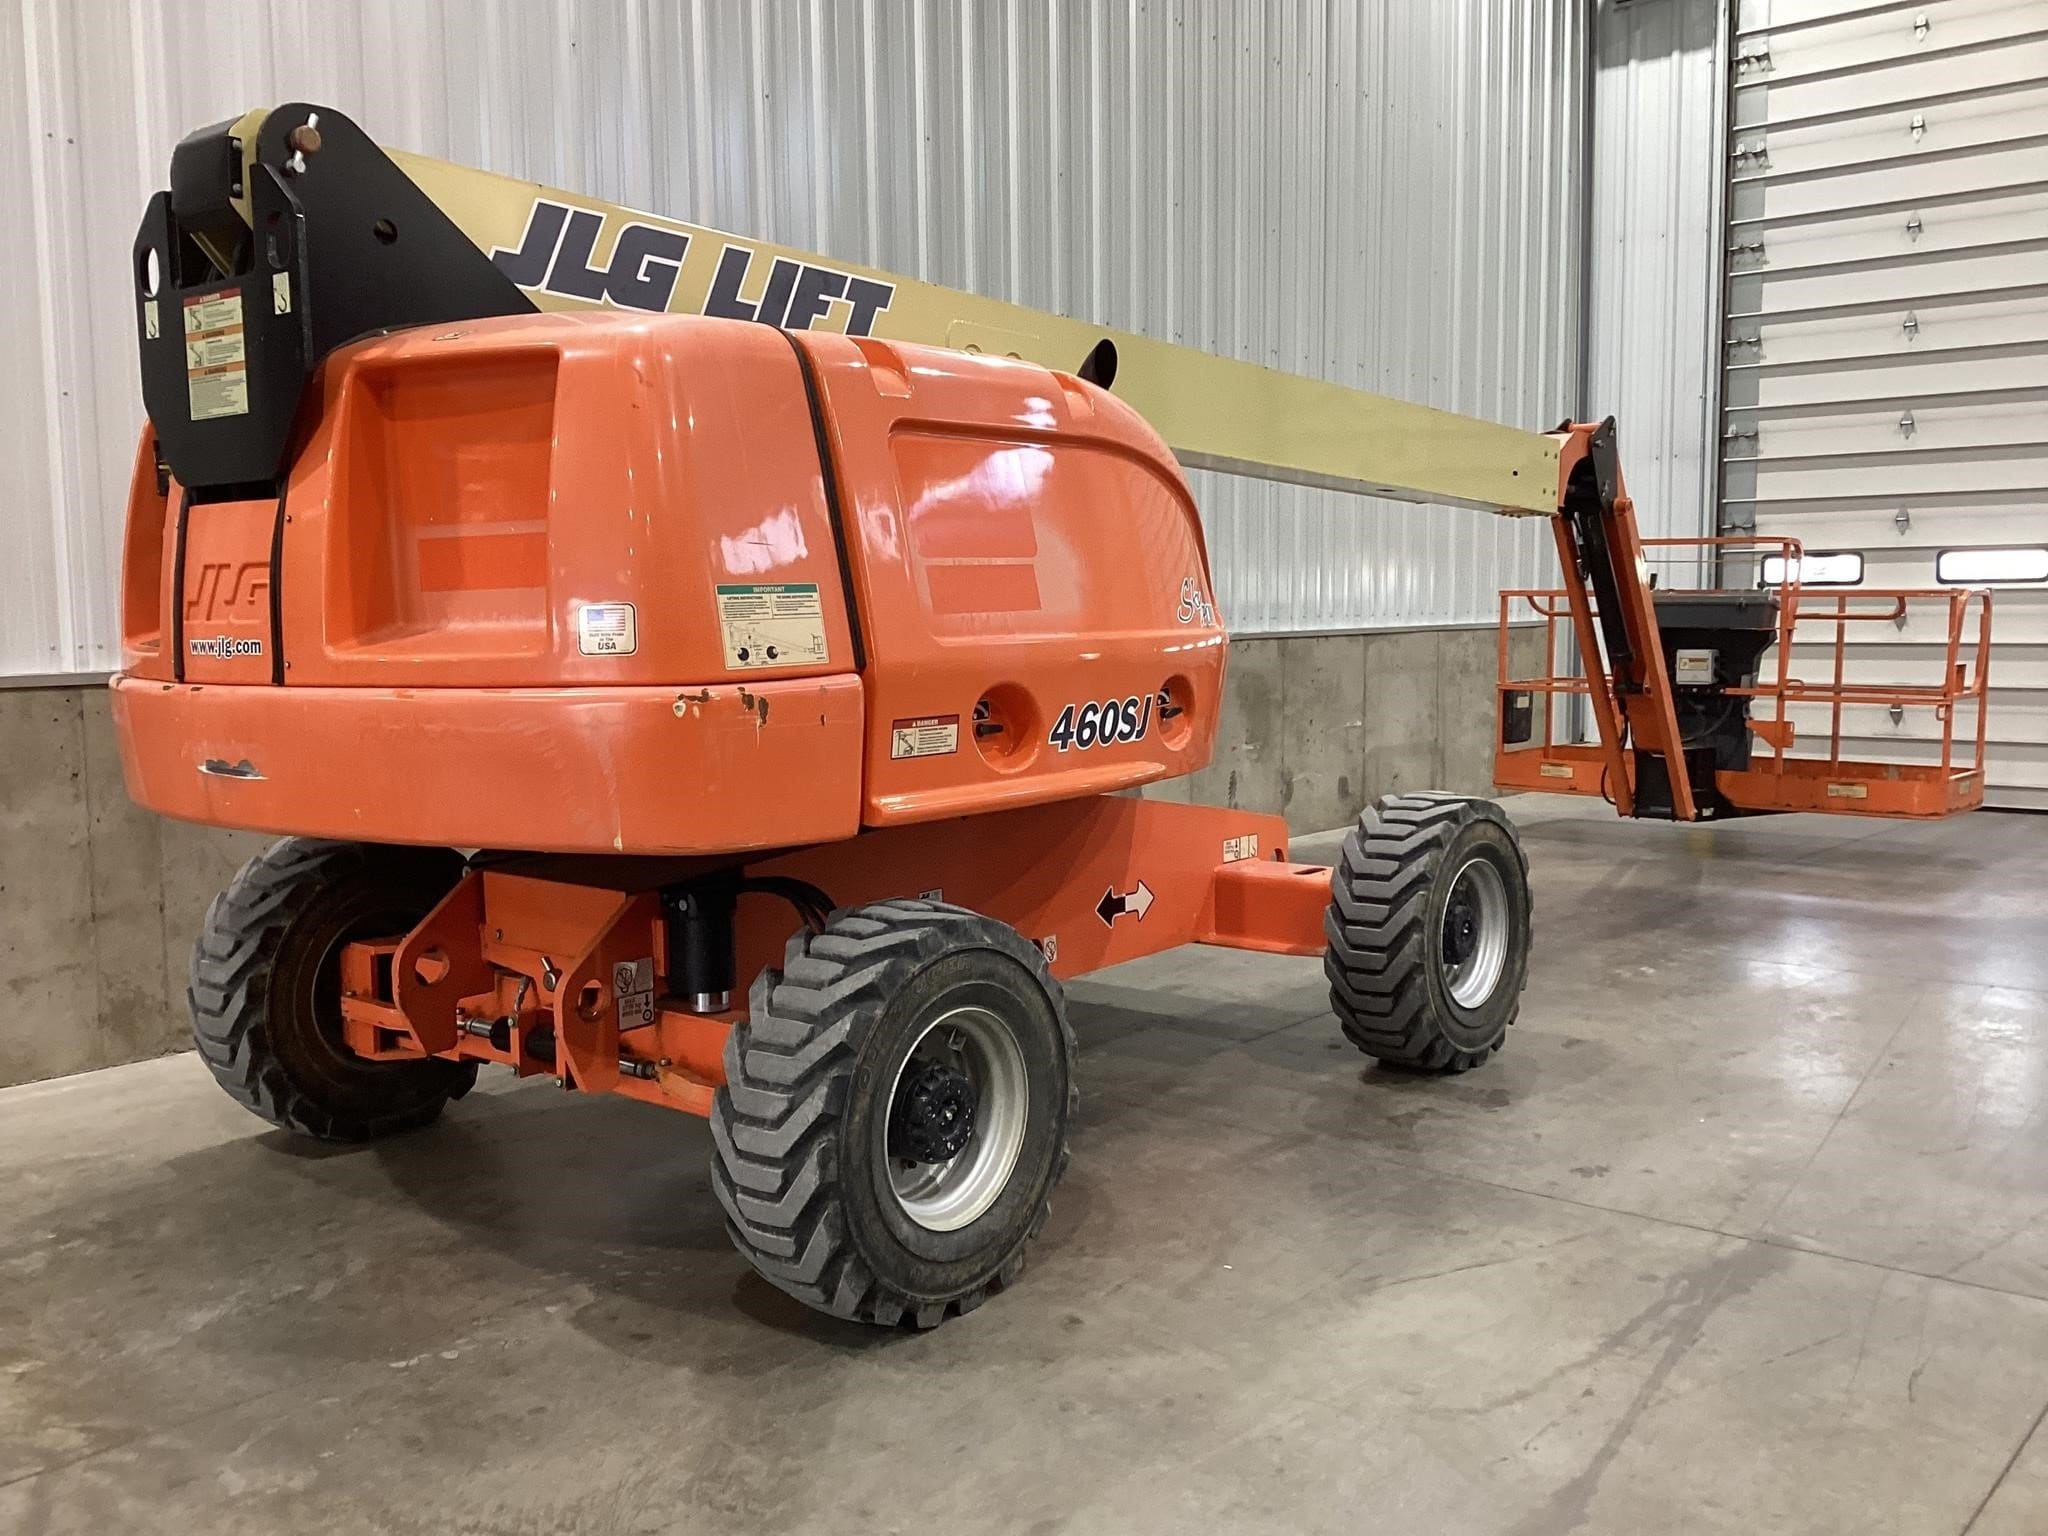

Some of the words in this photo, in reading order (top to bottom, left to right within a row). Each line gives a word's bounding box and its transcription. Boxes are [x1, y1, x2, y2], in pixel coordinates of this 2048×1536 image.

[489, 197, 693, 312] JLG
[704, 242, 897, 337] LIFT
[190, 635, 263, 659] www.jlg.com
[597, 642, 617, 651] USA
[916, 719, 939, 727] DANGER
[1048, 693, 1154, 753] 460SJ
